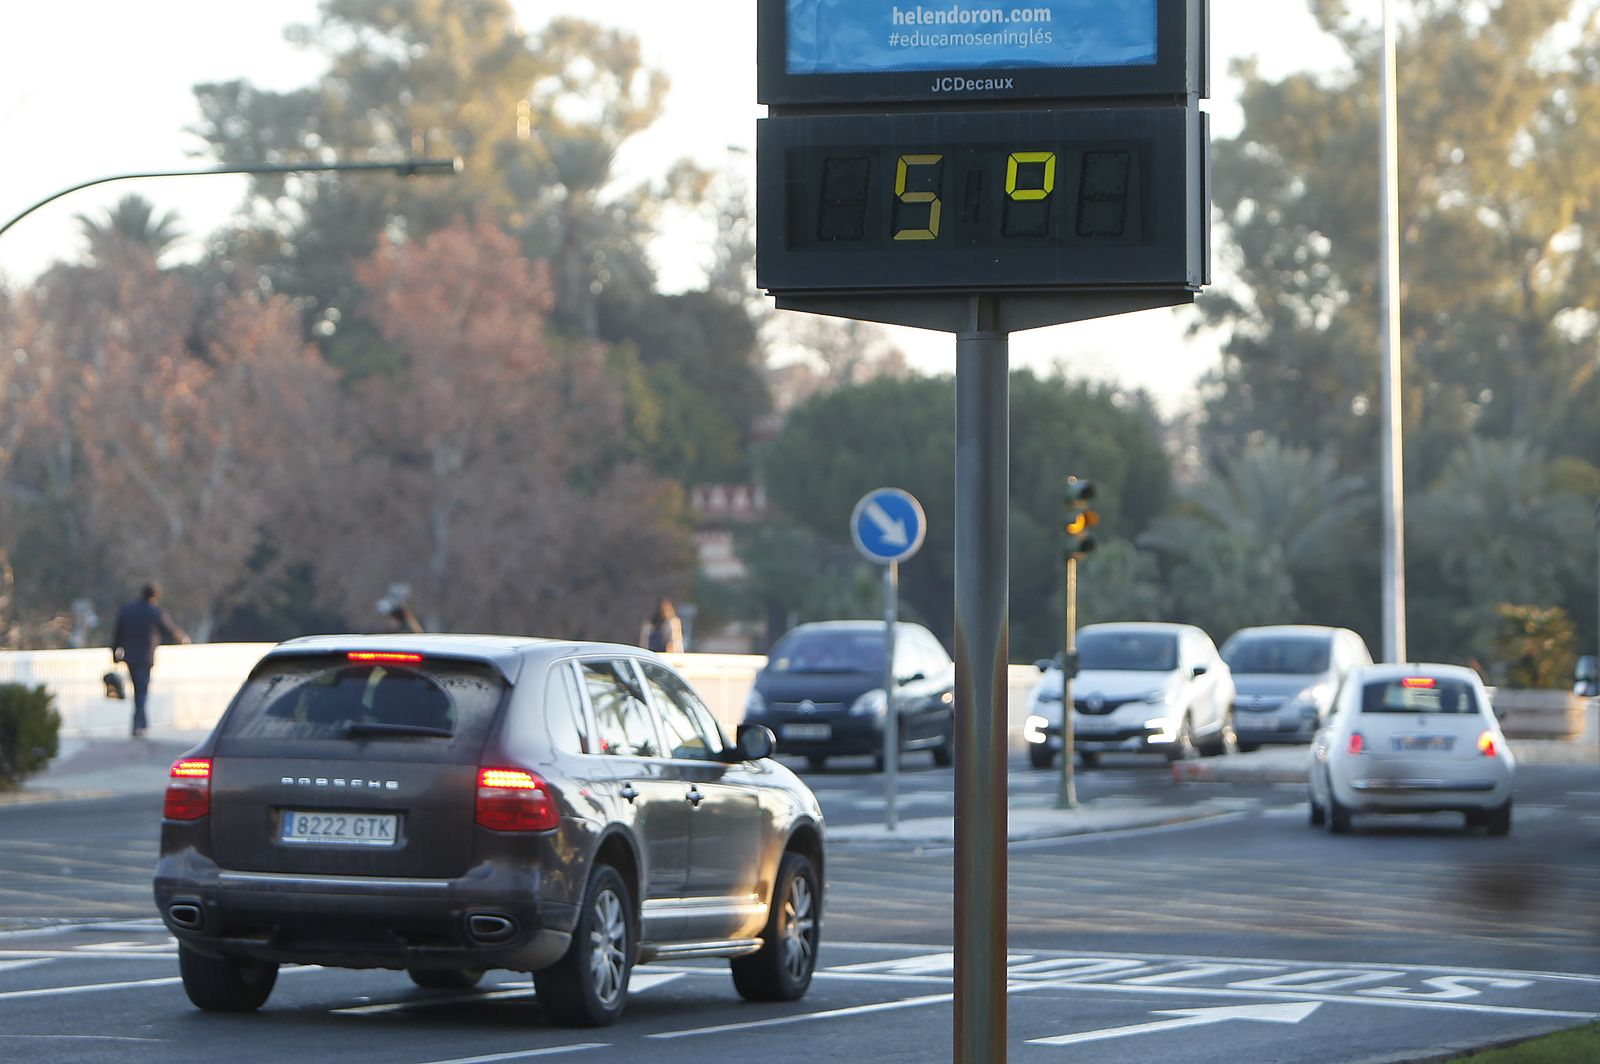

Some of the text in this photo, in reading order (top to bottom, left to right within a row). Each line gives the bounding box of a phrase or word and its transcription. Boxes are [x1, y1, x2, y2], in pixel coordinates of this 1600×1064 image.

[892, 5, 1052, 25] helendoron.com
[888, 28, 1053, 48] #educamoseninglés
[931, 77, 1014, 92] JCDecaux
[297, 816, 390, 837] 8222 GTK
